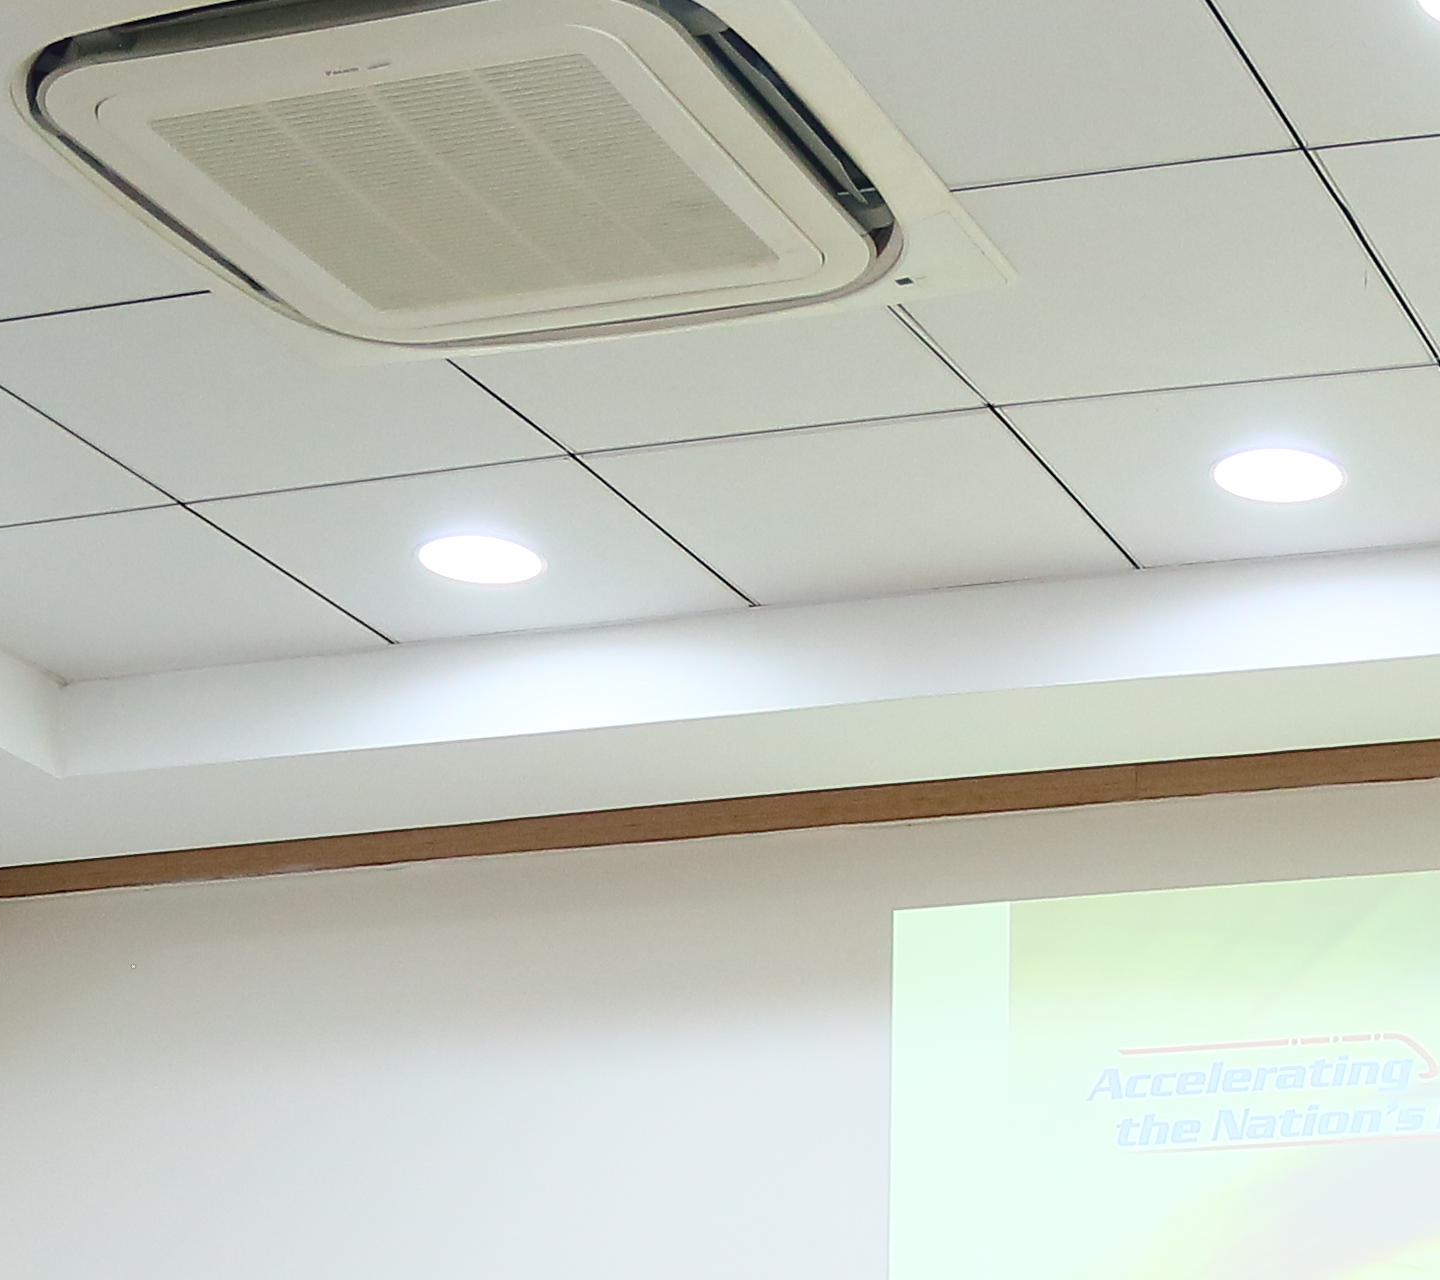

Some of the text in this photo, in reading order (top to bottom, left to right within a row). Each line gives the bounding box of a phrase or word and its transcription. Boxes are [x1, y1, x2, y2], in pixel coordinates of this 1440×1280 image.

[1085, 1054, 1415, 1102] Accelerating
[1116, 1112, 1200, 1147] the
[1211, 1101, 1425, 1144] Nation's
